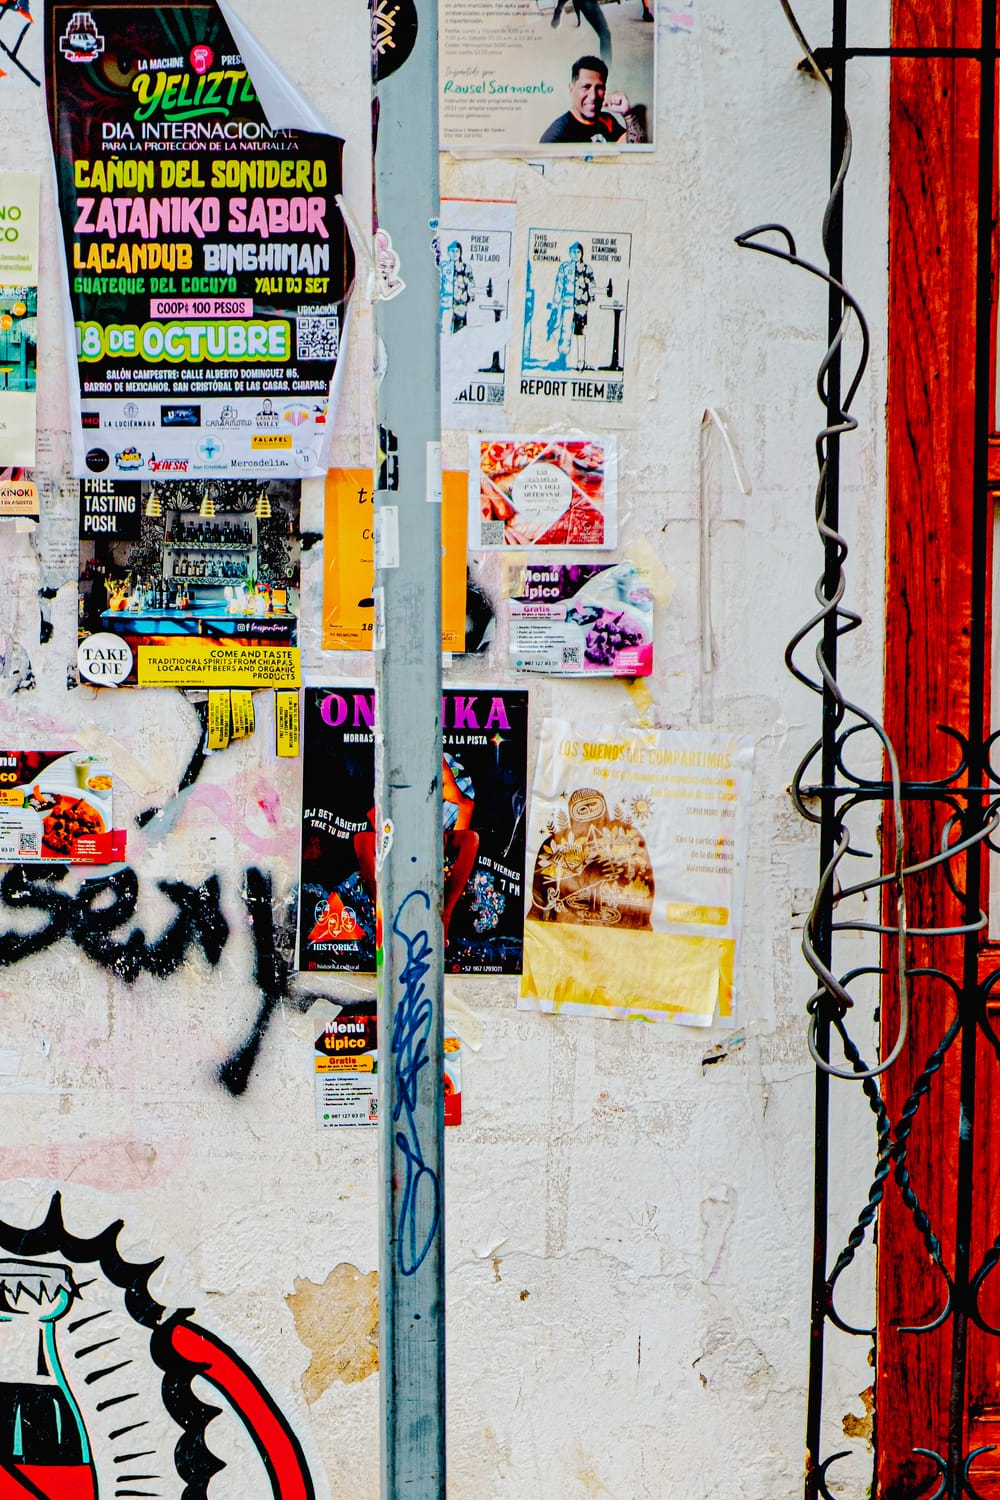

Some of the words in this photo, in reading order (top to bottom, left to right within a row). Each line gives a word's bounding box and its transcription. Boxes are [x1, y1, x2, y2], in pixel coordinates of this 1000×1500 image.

[138, 59, 148, 71] LA
[150, 56, 184, 70] MACHINE
[131, 70, 260, 121] YELIZTL
[102, 122, 134, 139] DIA
[102, 141, 127, 151] PARA
[130, 142, 142, 151] LA
[145, 141, 206, 151] PROTECCIÓN
[209, 142, 222, 151] DE
[225, 142, 237, 151] LA
[74, 156, 154, 192] CAÑON
[160, 160, 205, 189] DEL
[211, 160, 327, 192] SONIDERO
[74, 197, 220, 239] ZATANIKO
[228, 197, 330, 239] SABOR
[73, 242, 193, 274] LACANDUB
[74, 277, 145, 295] GUATEQUE
[151, 277, 176, 293] DEL
[181, 277, 237, 293] COCUYO
[255, 278, 282, 295] YALI
[286, 278, 302, 294] DJ
[305, 278, 330, 294] SET
[192, 302, 210, 314] 100
[214, 302, 245, 314] PESOS
[109, 329, 135, 350] DE
[143, 326, 285, 356] OCTUBRE
[106, 369, 131, 380] SALÓN
[133, 369, 179, 380] CAMPESTRE:
[181, 370, 204, 380] CALLE
[206, 369, 239, 379] ALBERTO
[241, 369, 284, 379] DOMINGUEZ
[520, 379, 567, 396] REPORT
[571, 382, 605, 398] THEM
[1, 488, 33, 497] KINOKI
[84, 479, 114, 493] FREE
[84, 496, 136, 514] TASTING
[84, 515, 117, 532] POSH
[523, 605, 551, 613] Gratis
[82, 648, 128, 662] TAKE
[211, 650, 239, 658] COME
[241, 650, 261, 658] AND
[263, 651, 292, 659] TASTE
[88, 662, 123, 676] ONE
[252, 672, 296, 681] PRODUCTS
[304, 808, 316, 819] DJ
[318, 810, 334, 823] SET
[335, 815, 367, 832] ABIERTO
[478, 855, 492, 866] LOS
[493, 860, 521, 881] VIERNES
[313, 942, 359, 952] HISTORIKA
[325, 1020, 365, 1034] Menú
[324, 1034, 366, 1050] típico
[329, 1057, 357, 1065] Gratis
